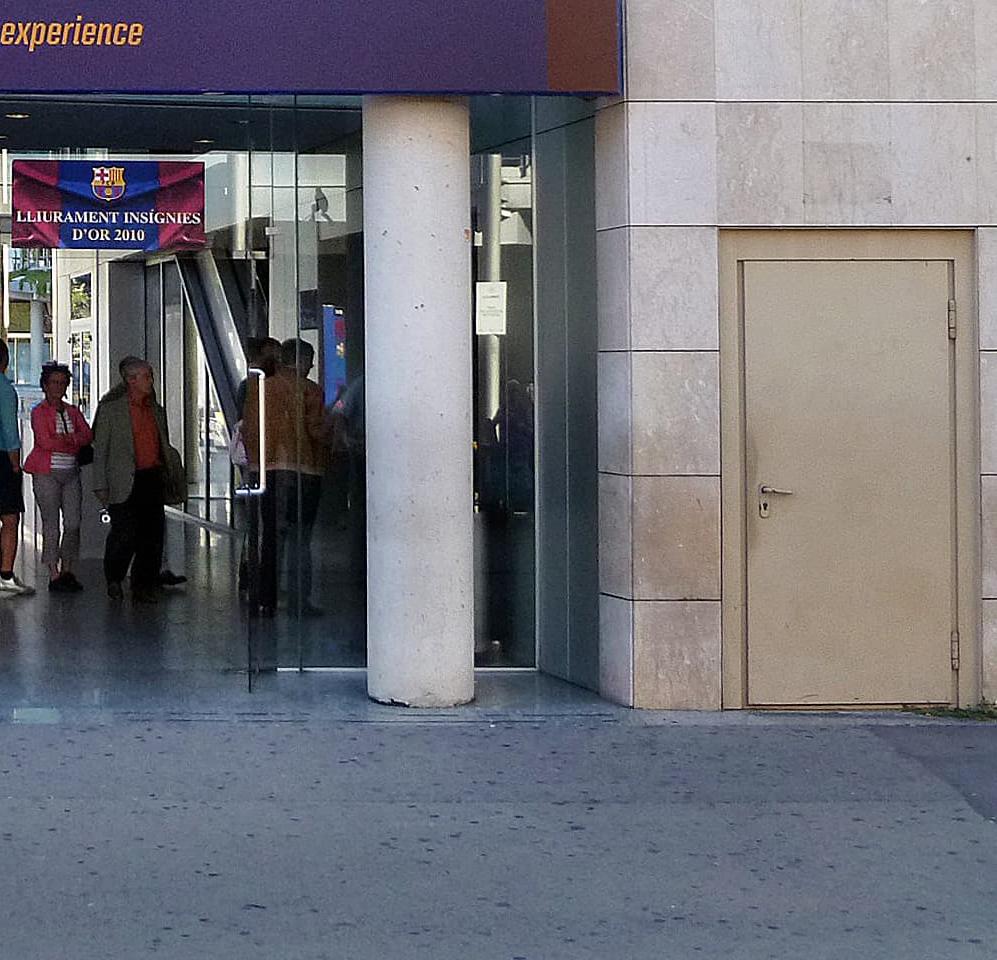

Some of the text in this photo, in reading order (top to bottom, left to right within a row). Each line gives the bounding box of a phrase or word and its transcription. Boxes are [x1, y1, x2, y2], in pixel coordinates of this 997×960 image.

[0, 15, 143, 52] experience
[16, 208, 202, 224] LLIURAMENT INSÍGNIES
[72, 228, 145, 241] D'OR 2010
